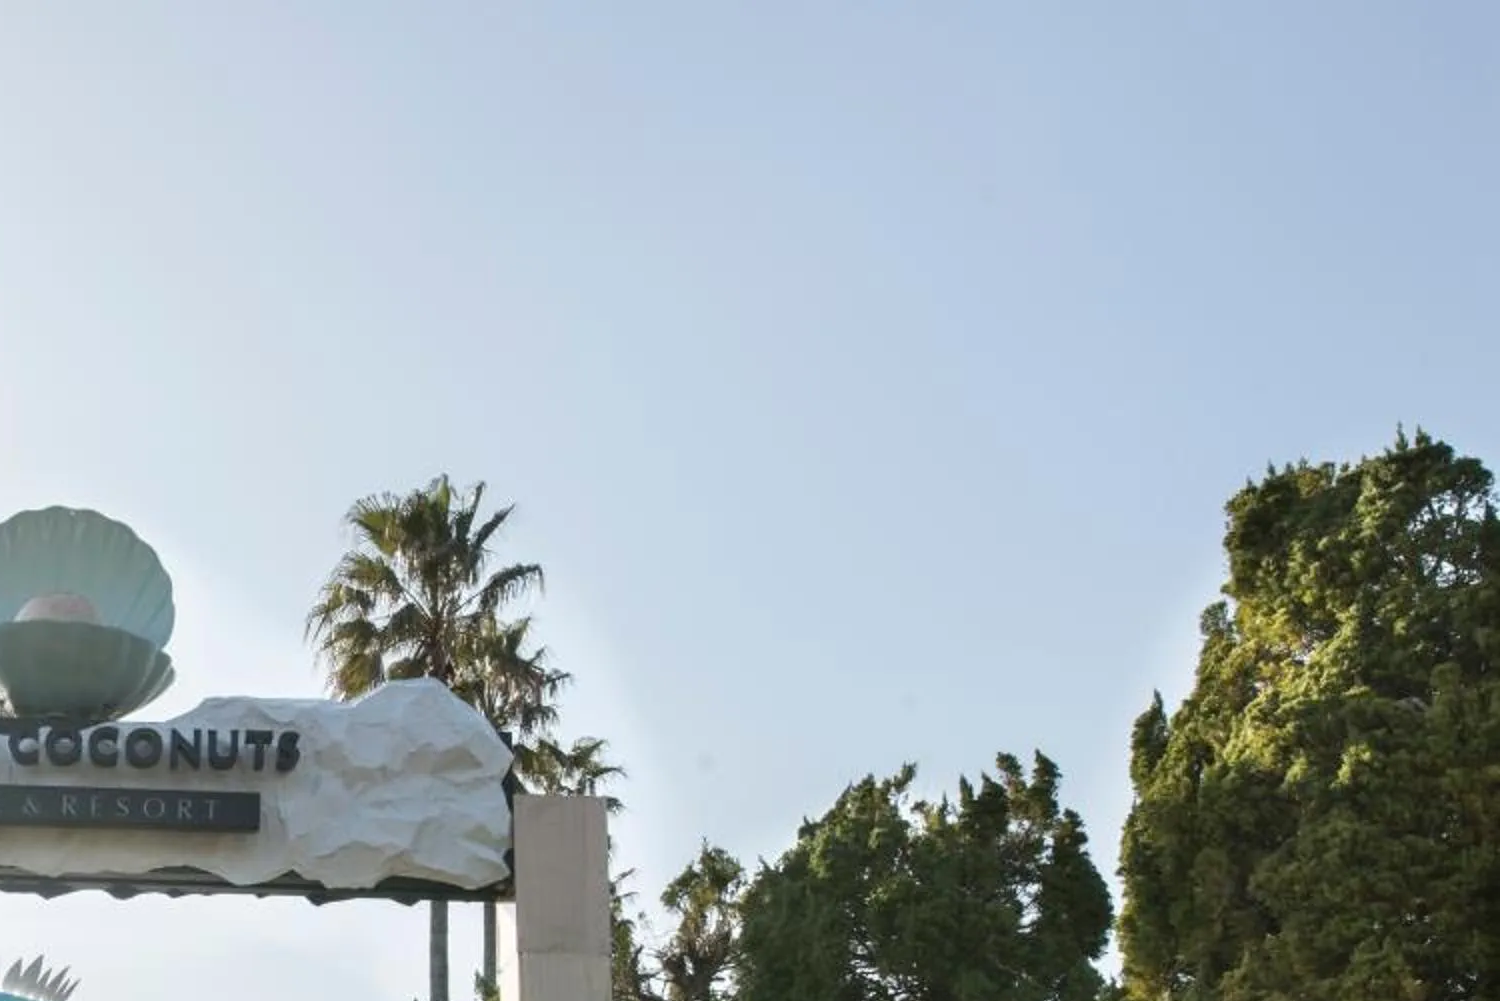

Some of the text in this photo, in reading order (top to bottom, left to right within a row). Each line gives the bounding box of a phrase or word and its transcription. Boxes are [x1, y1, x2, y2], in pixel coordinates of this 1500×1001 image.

[8, 722, 302, 772] COCONUTS
[21, 796, 42, 816] &
[60, 793, 222, 821] RESORT
